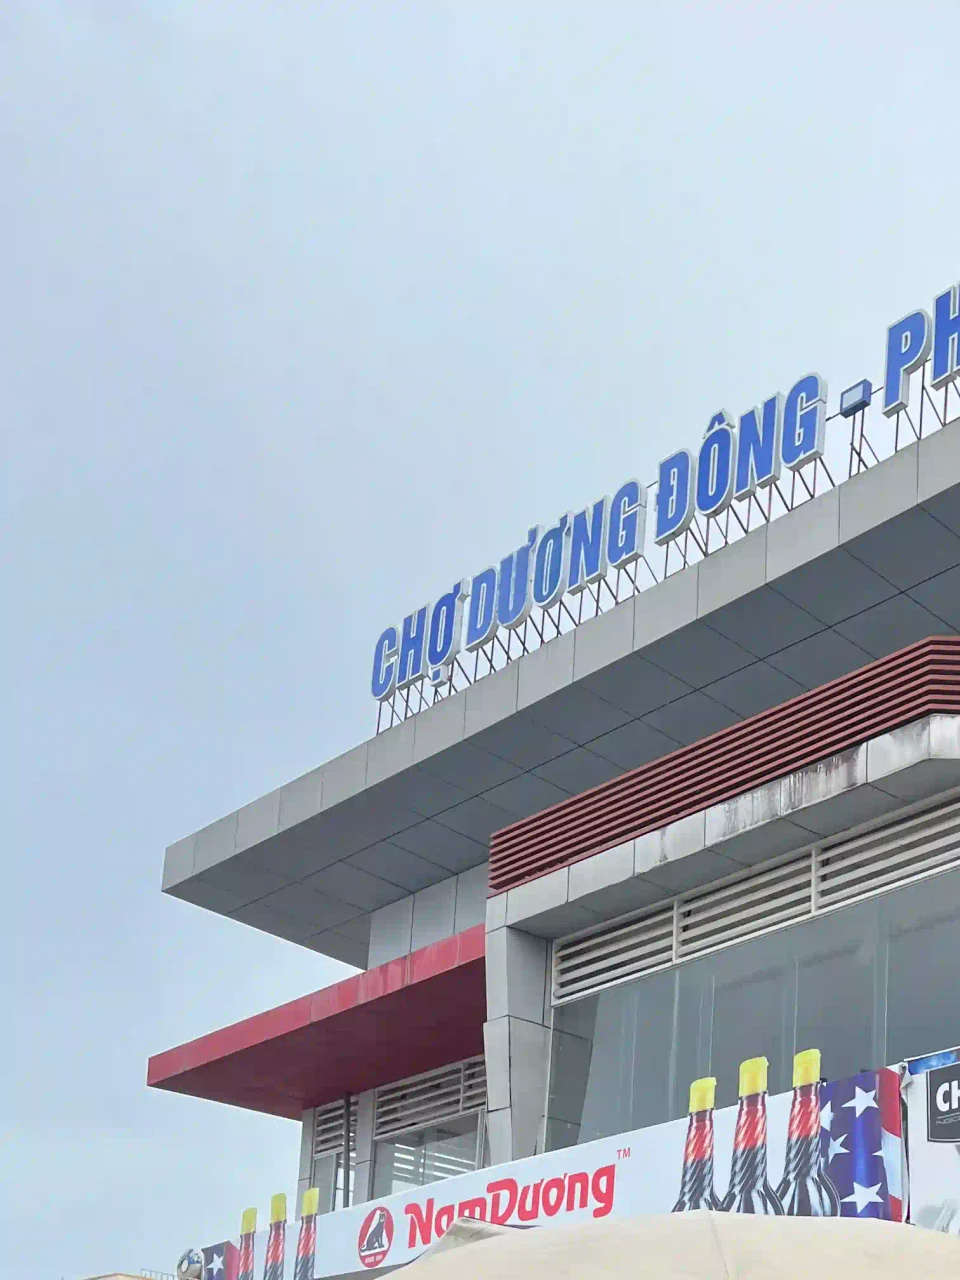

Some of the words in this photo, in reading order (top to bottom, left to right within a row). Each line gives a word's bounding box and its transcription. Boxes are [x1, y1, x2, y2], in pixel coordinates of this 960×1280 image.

[371, 577, 470, 701] CHỢ
[466, 478, 648, 651] DƯƠNG
[654, 372, 828, 546] ĐÔNG
